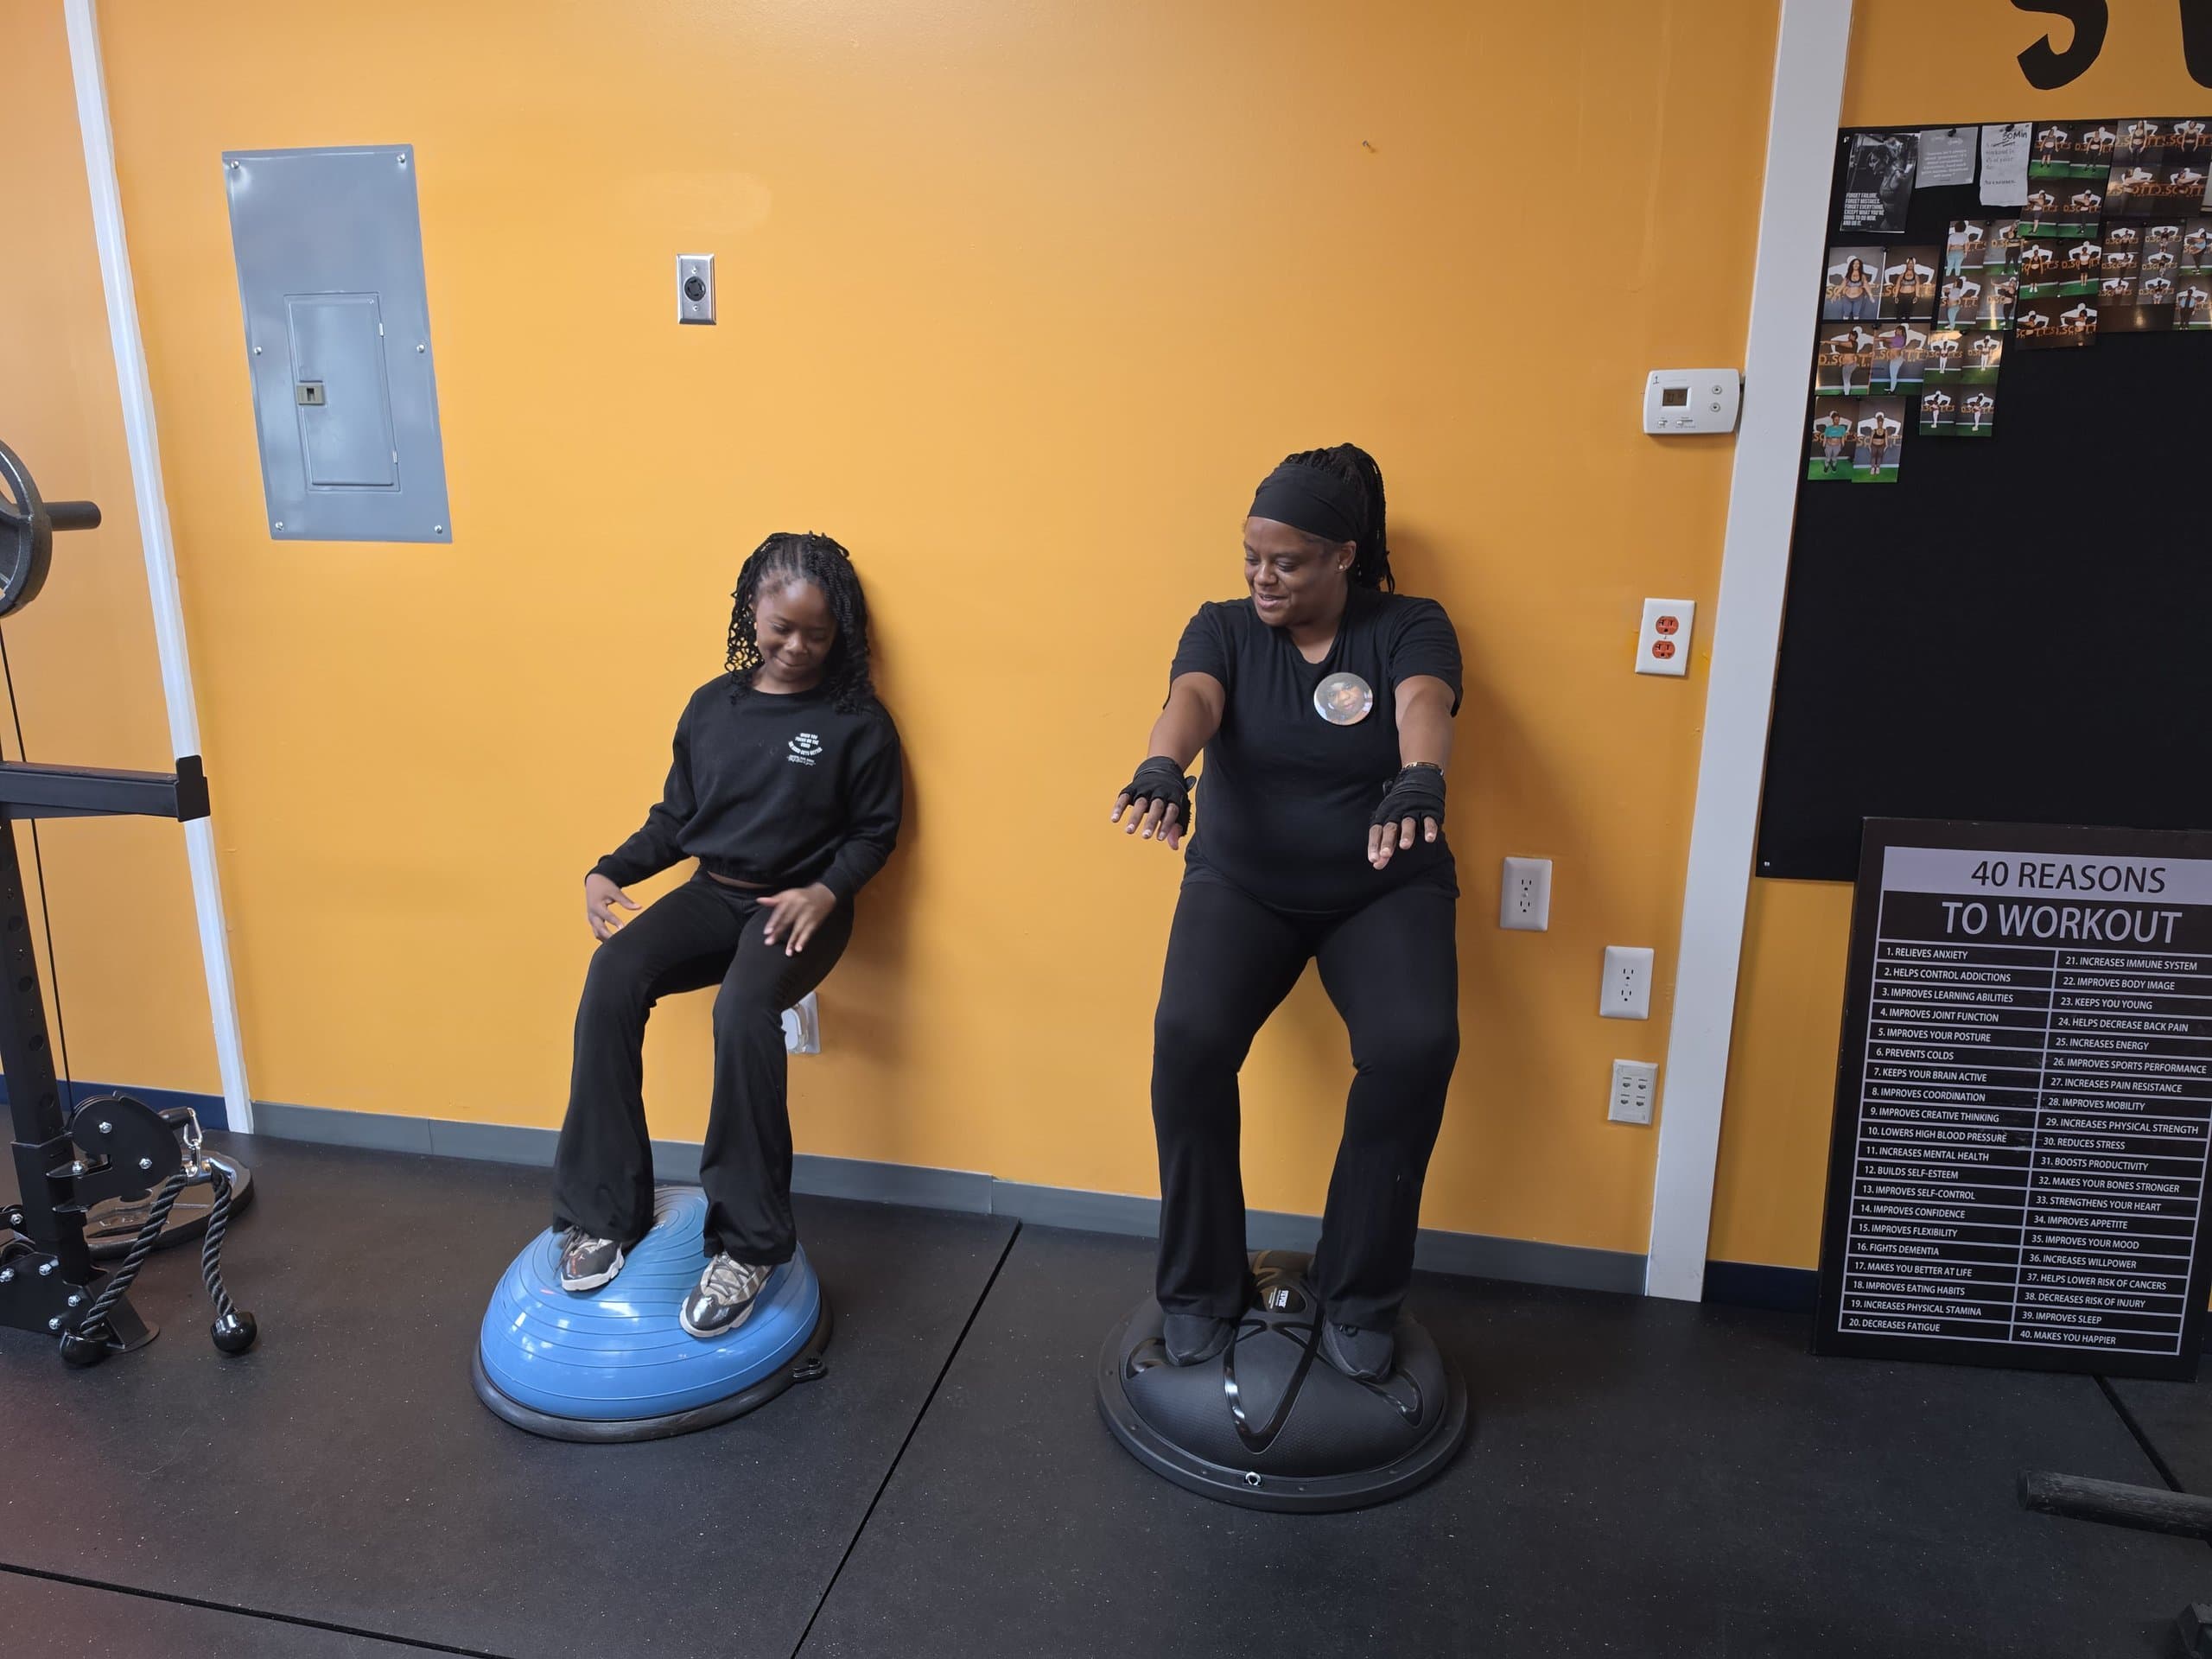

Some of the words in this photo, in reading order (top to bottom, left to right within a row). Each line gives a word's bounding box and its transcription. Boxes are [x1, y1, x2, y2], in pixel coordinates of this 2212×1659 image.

[1970, 861, 2009, 887] 40
[2018, 861, 2166, 893] REASONS
[1942, 901, 1987, 935] TO
[1998, 903, 2183, 944] WORKOUT
[1886, 946, 1894, 956] 1.
[1894, 947, 1932, 958] RELIEVES
[1932, 949, 1968, 960] ANXIETY
[2065, 956, 2078, 965] 21.
[2079, 957, 2125, 967] INCREASES
[2126, 958, 2163, 969] IMMUNE
[2163, 960, 2197, 970] SYSTEM
[1884, 967, 1892, 976] 2.
[1892, 967, 1919, 978] HELPS
[1919, 969, 1959, 980] CONTROL
[1960, 971, 2011, 982] ADDICTIONS
[2063, 976, 2075, 986] 22.
[2076, 977, 2120, 988] IMPROVES
[2120, 978, 2146, 988] BODY
[2146, 980, 2176, 990] IMAGE
[1881, 987, 1890, 996] 3.
[1891, 988, 1933, 999] IMPROVES
[1933, 990, 1975, 1001] LEARNING
[1975, 992, 2013, 1003] ABILITIES
[2060, 996, 2073, 1006] 23.
[2074, 997, 2101, 1007] KEEPS
[2101, 998, 2120, 1008] YOU
[2121, 1000, 2152, 1010] YOUNG
[1879, 1007, 1888, 1016] 4.
[1889, 1007, 1931, 1019] IMPROVES
[1931, 1010, 1956, 1020] JOINT
[1956, 1011, 1999, 1022] FUNCTION
[2057, 1016, 2070, 1026] 24.
[2071, 1017, 2098, 1027] HELPS
[2099, 1019, 2143, 1030] DECREASE
[2143, 1021, 2167, 1031] BACK
[2167, 1022, 2189, 1033] PAIN
[1878, 1027, 1885, 1036] 5.
[1886, 1027, 1929, 1039] IMPROVES
[1929, 1030, 1953, 1040] YOUR
[1953, 1031, 1992, 1042] POSTURE
[2055, 1037, 2069, 1046] 25.
[2069, 1038, 2114, 1049] INCREASES
[2115, 1039, 2150, 1051] ENERGY
[2052, 1057, 2066, 1066] 26.
[2066, 1058, 2109, 1069] IMPROVES
[2110, 1059, 2143, 1071] SPORTS
[2143, 1062, 2207, 1074] PERFORMANCE
[1873, 1067, 1881, 1076] 7.
[1882, 1067, 1907, 1077] KEEPS
[1908, 1069, 1932, 1079] YOUR
[1931, 1070, 1958, 1080] BRAIN
[1958, 1071, 1987, 1083] ACTIVE
[2050, 1077, 2063, 1086] 27.
[2064, 1077, 2109, 1089] INCREASES
[2110, 1080, 2131, 1090] PAIN
[2132, 1081, 2183, 1093] RESISTANCE
[1870, 1106, 1878, 1116] 9.
[1878, 1107, 1920, 1118] IMPROVES
[1921, 1109, 1960, 1121] CREATIVE
[1960, 1111, 1999, 1122] THINKING
[2045, 1117, 2059, 1127] 29.
[2060, 1117, 2107, 1129] INCREASES
[2108, 1121, 2151, 1132] PHYSICAL
[2152, 1123, 2199, 1135] STRENGTH
[1868, 1126, 1879, 1135] 10.
[1880, 1127, 1914, 1138] LOWERS
[1915, 1128, 1936, 1139] HIGH
[1936, 1130, 1966, 1141] BLOOD
[1966, 1132, 2007, 1143] PRESSURE
[2043, 1136, 2056, 1146] 30.
[2056, 1137, 2094, 1148] REDUCES
[2095, 1140, 2126, 1150] STRESS
[1866, 1146, 1878, 1155] 11.
[1878, 1147, 1922, 1158] INCREASES
[1923, 1149, 1956, 1160] MENTAL
[1956, 1151, 1989, 1161] HEALTH
[2038, 1175, 2051, 1185] 32.
[2051, 1176, 2081, 1187] MAKES
[2082, 1179, 2106, 1188] YOUR
[2106, 1179, 2134, 1190] BONES
[2135, 1181, 2180, 1193] STRONGER
[1863, 1185, 1874, 1194] 13.
[1875, 1185, 1916, 1196] IMPROVES
[1916, 1187, 1975, 1200] SELF-CONTROL
[2035, 1195, 2049, 1205] 33.
[2049, 1196, 2108, 1208] STRENGTHENS
[2109, 1199, 2133, 1210] YOUR
[2133, 1202, 2162, 1211] HEART
[1859, 1223, 1870, 1232] 15.
[1871, 1224, 1911, 1235] IMPROVES
[1912, 1226, 1958, 1237] FLEXIBILITY
[2031, 1234, 2044, 1243] 35.
[2044, 1235, 2087, 1246] IMPROVES
[2088, 1237, 2112, 1248] YOUR
[2112, 1239, 2139, 1249] MOOD
[1854, 1261, 1866, 1270] 17.
[1866, 1262, 1895, 1272] MAKES
[1895, 1264, 1913, 1273] YOU
[1914, 1265, 1943, 1275] BETTER
[1943, 1267, 1955, 1275] AT
[1955, 1268, 1973, 1277] LIFE
[1853, 1280, 1865, 1289] 18.
[1865, 1281, 1905, 1292] IMPROVES
[1906, 1283, 1936, 1294] EATING
[1936, 1286, 1965, 1296] HABITS
[2026, 1272, 2039, 1281] 37.
[2040, 1273, 2066, 1283] HELPS
[2066, 1275, 2096, 1286] LOWER
[2096, 1277, 2115, 1287] RISK
[2115, 1278, 2128, 1287] OF
[2128, 1279, 2167, 1290] CANCERS
[1851, 1299, 1862, 1308] 19.
[1863, 1300, 1905, 1311] INCREASES
[1906, 1302, 1944, 1313] PHYSICAL
[1945, 1305, 1981, 1316] STAMINA
[2024, 1292, 2037, 1300] 38.
[2037, 1292, 2084, 1304] DECREASES
[2084, 1295, 2103, 1306] RISK
[2103, 1297, 2116, 1306] OF
[2116, 1298, 2146, 1308] INJURY
[2019, 1330, 2032, 1338] 40.
[2033, 1331, 2062, 1341] MAKES
[2063, 1332, 2081, 1342] YOU
[2082, 1334, 2116, 1344] HAPPIER
